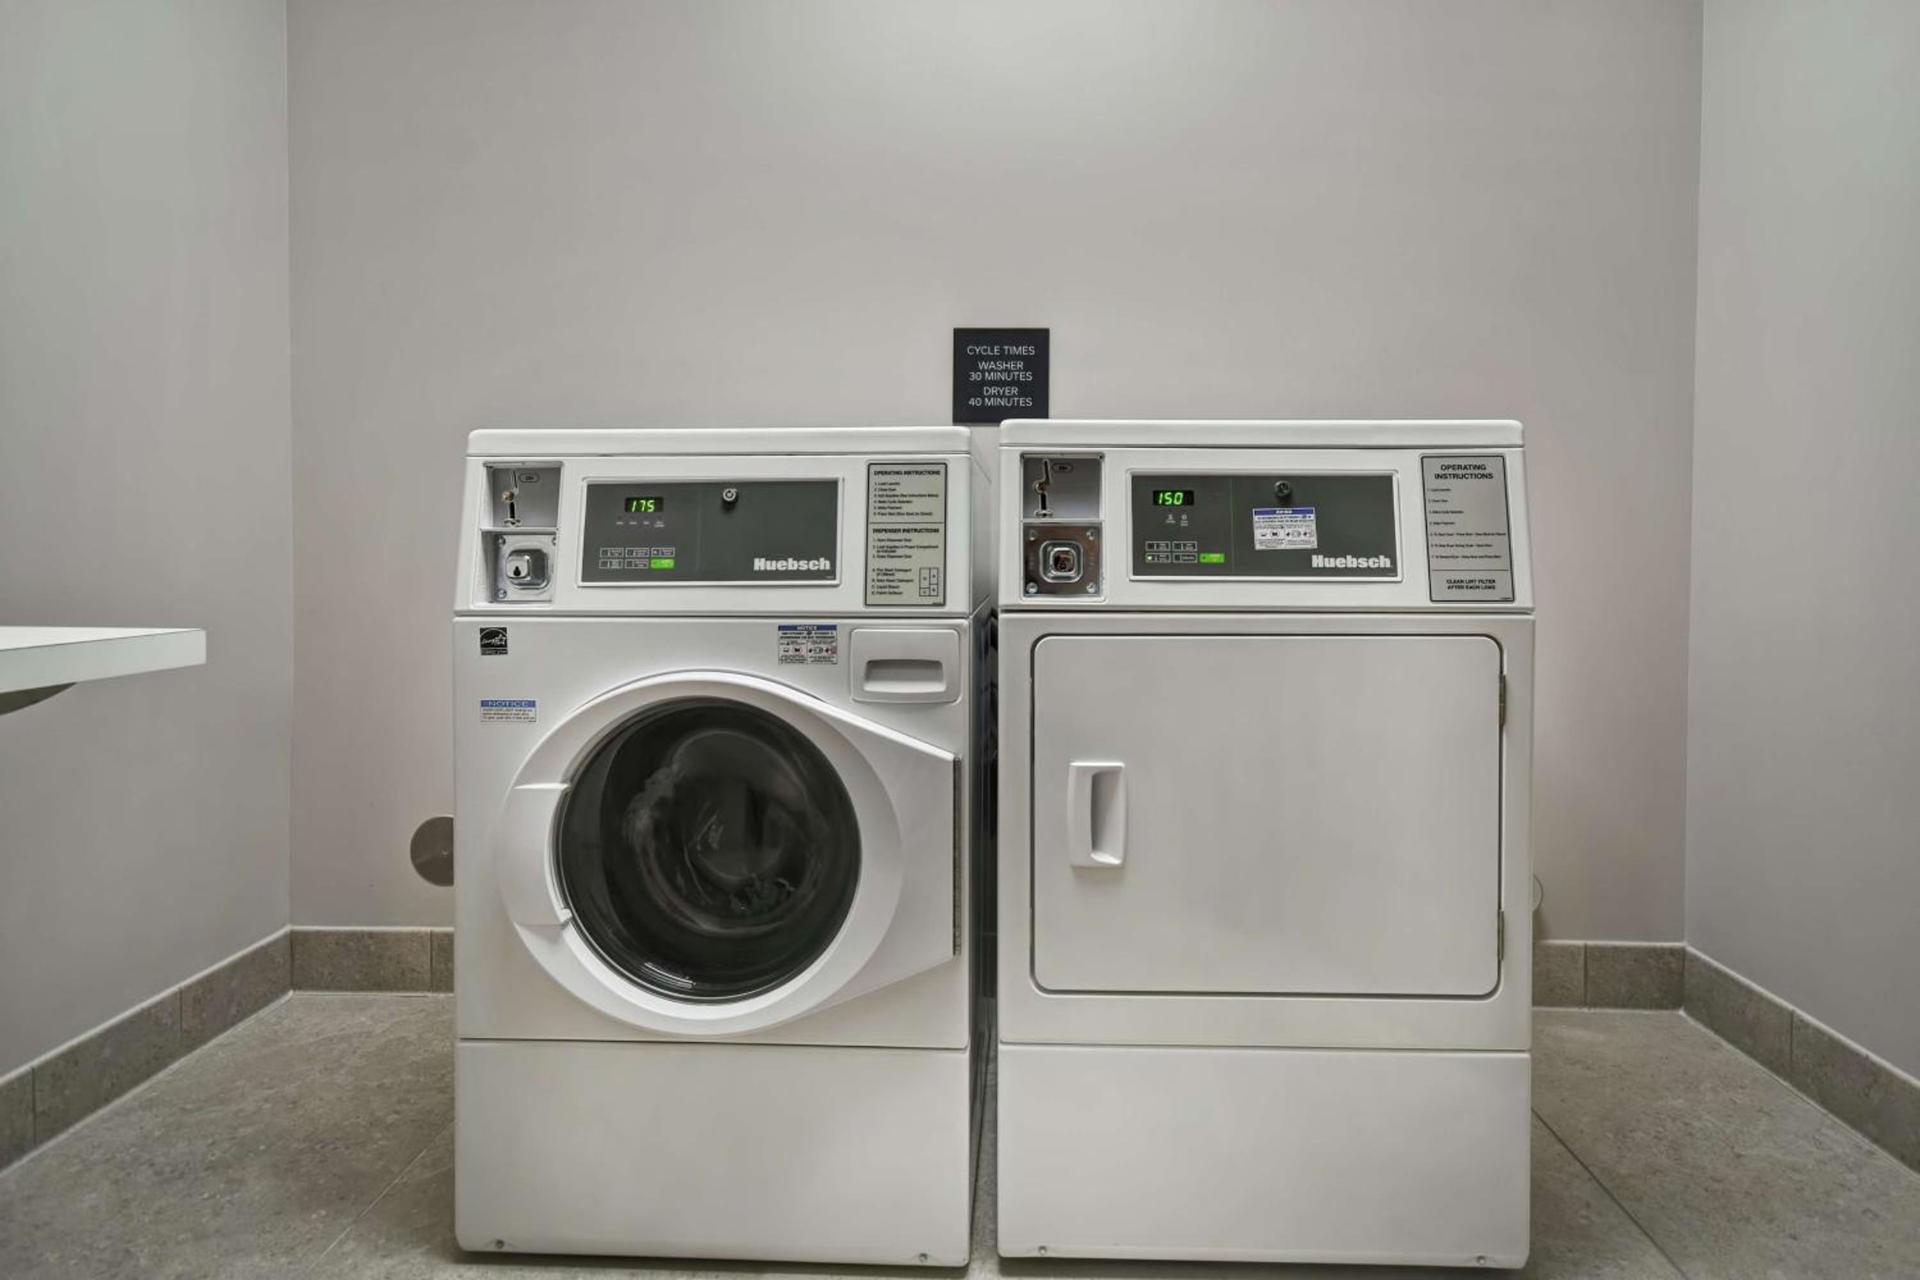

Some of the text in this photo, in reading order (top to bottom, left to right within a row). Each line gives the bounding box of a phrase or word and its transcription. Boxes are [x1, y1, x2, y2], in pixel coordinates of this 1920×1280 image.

[966, 345, 1036, 356] CYCLE TIMES
[978, 360, 1024, 370] WASHER
[968, 371, 1033, 381] 30 MINUTES
[983, 386, 1019, 396] DRYER
[968, 397, 1033, 407] 40 MINUTES
[1159, 492, 1184, 505] 150
[631, 500, 655, 513] 175
[753, 557, 831, 571] Huebsch
[1311, 554, 1391, 568] Huebsch
